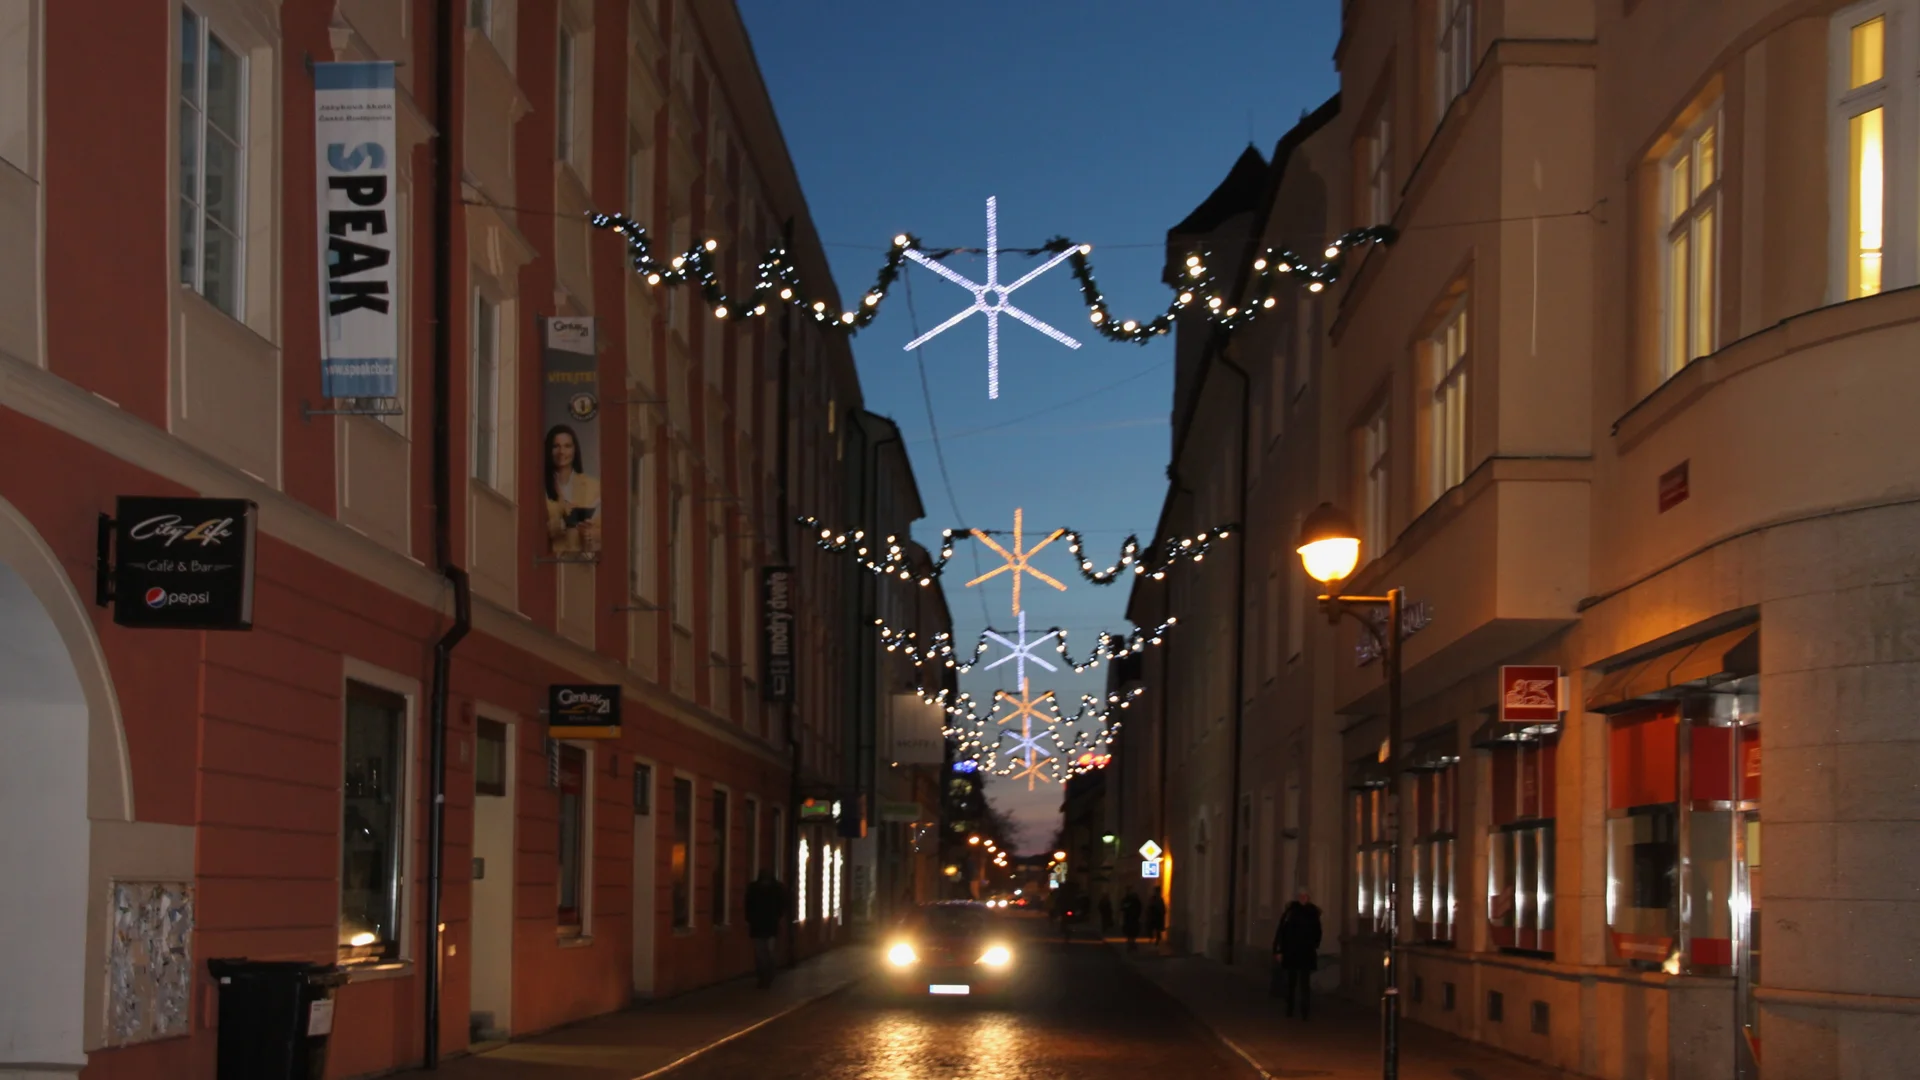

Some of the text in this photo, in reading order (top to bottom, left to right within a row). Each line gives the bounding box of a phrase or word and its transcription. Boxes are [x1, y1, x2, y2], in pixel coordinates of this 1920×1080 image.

[327, 142, 390, 316] SPEAK
[130, 514, 234, 547] City Life
[147, 559, 213, 572] Café & Bar
[168, 591, 210, 606] pepsi
[558, 688, 611, 714] Century 21
